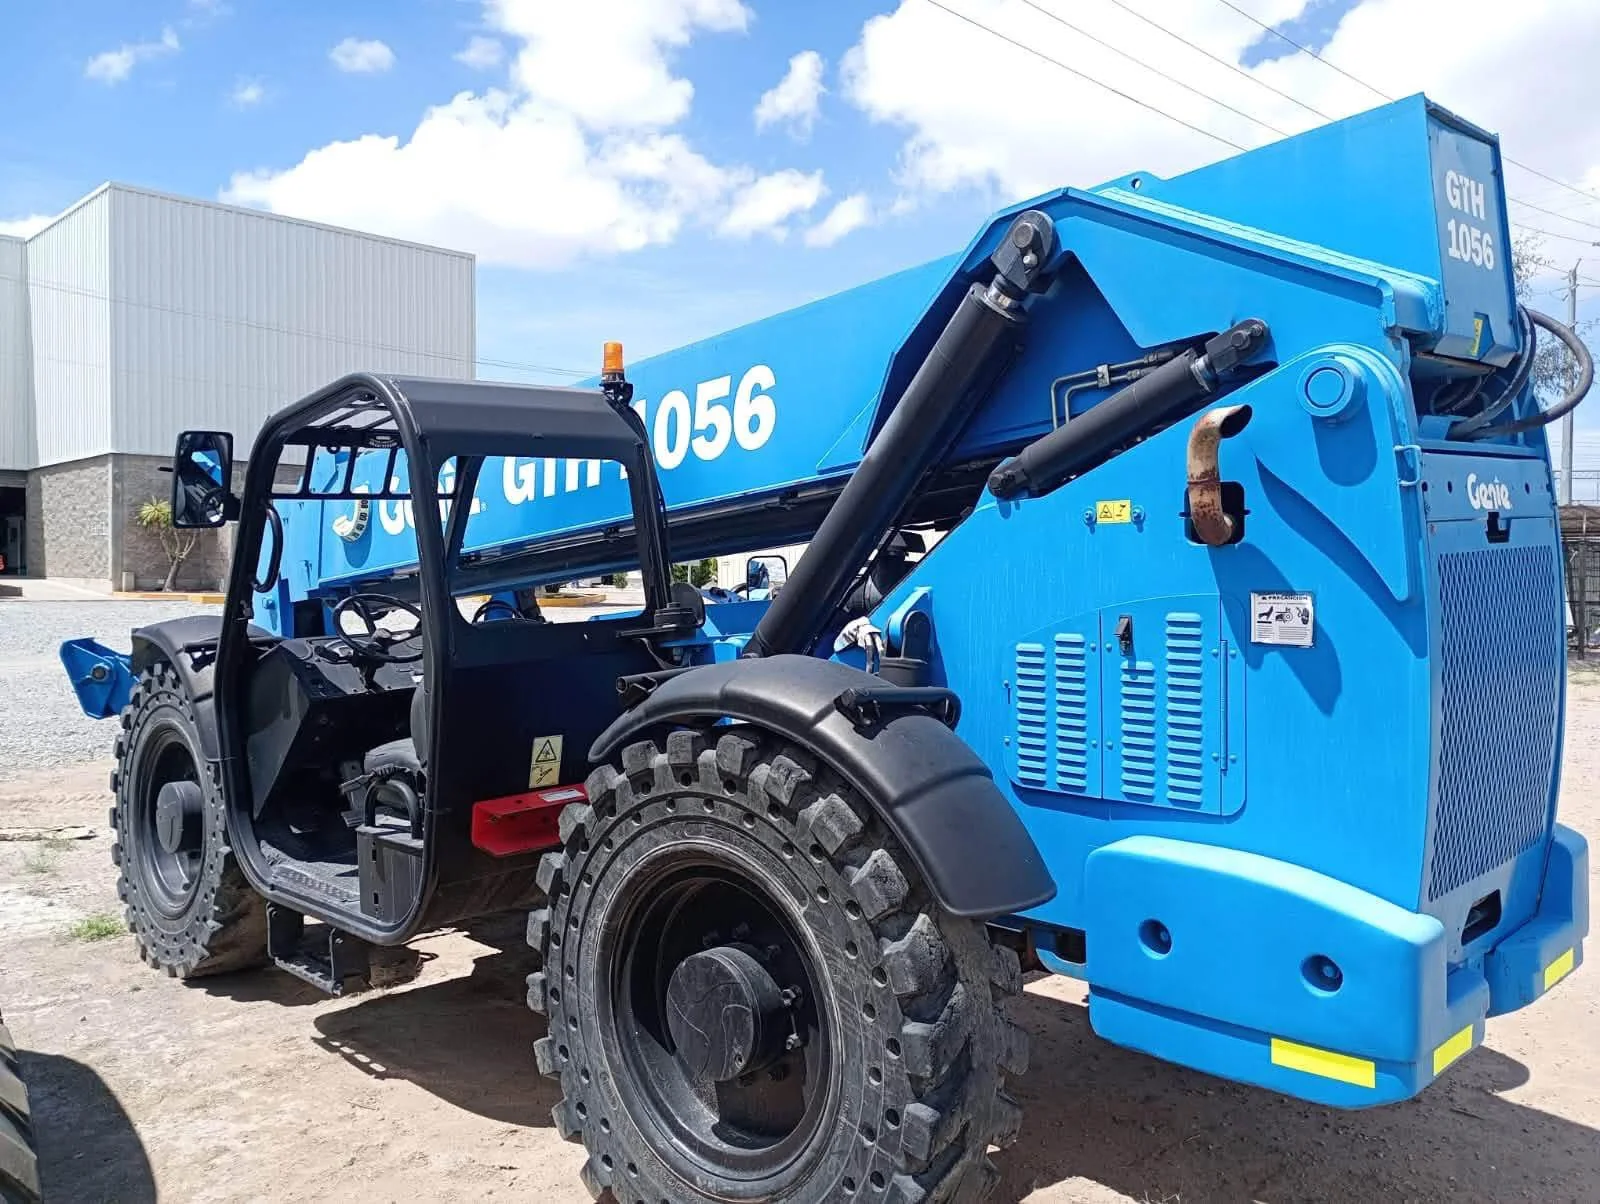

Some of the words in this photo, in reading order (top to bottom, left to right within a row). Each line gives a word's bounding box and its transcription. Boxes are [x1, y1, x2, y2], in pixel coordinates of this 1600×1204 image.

[1446, 170, 1485, 219] GTH
[1448, 220, 1494, 270] 1056
[1466, 472, 1513, 510] Genie
